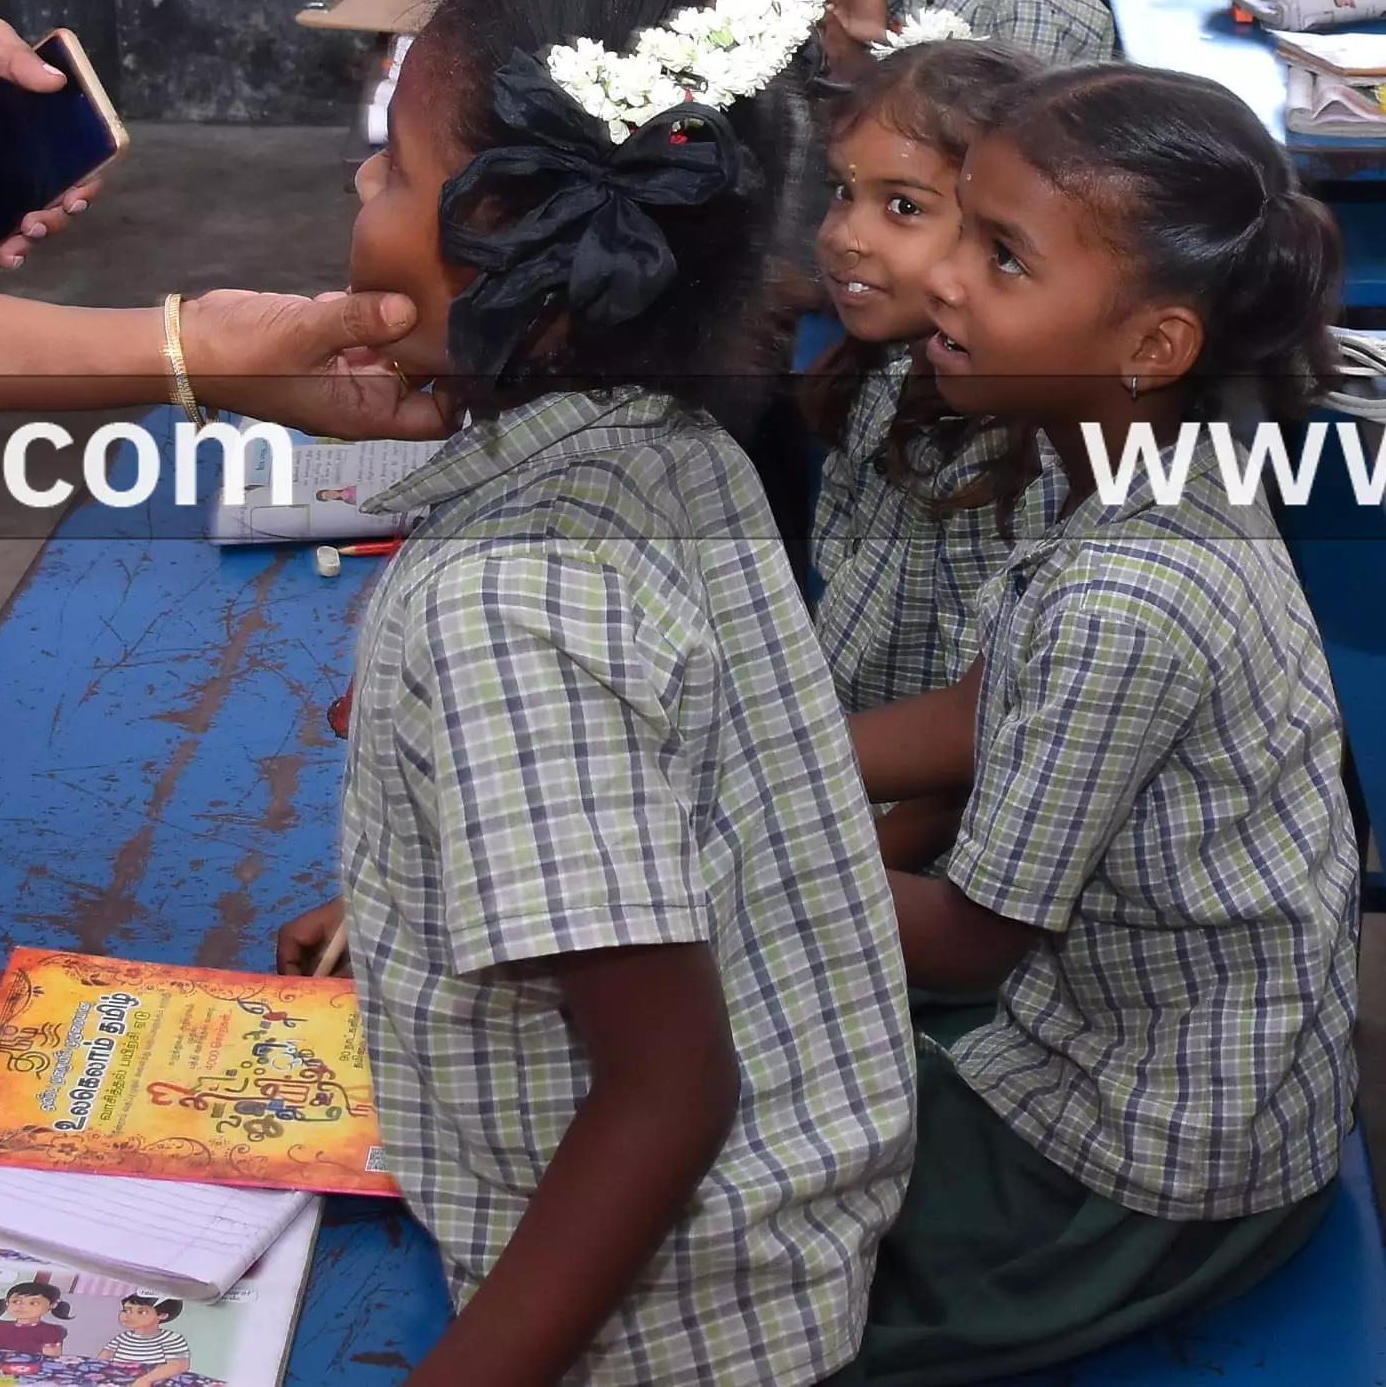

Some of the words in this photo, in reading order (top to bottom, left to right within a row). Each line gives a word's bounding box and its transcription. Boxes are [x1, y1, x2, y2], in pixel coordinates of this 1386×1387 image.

[53, 1037, 115, 1131] உலகெலாம்
[94, 991, 142, 1035] தமிழ்
[99, 1069, 128, 1121] வாசித்தல்
[120, 1030, 142, 1068] பயிற்சி
